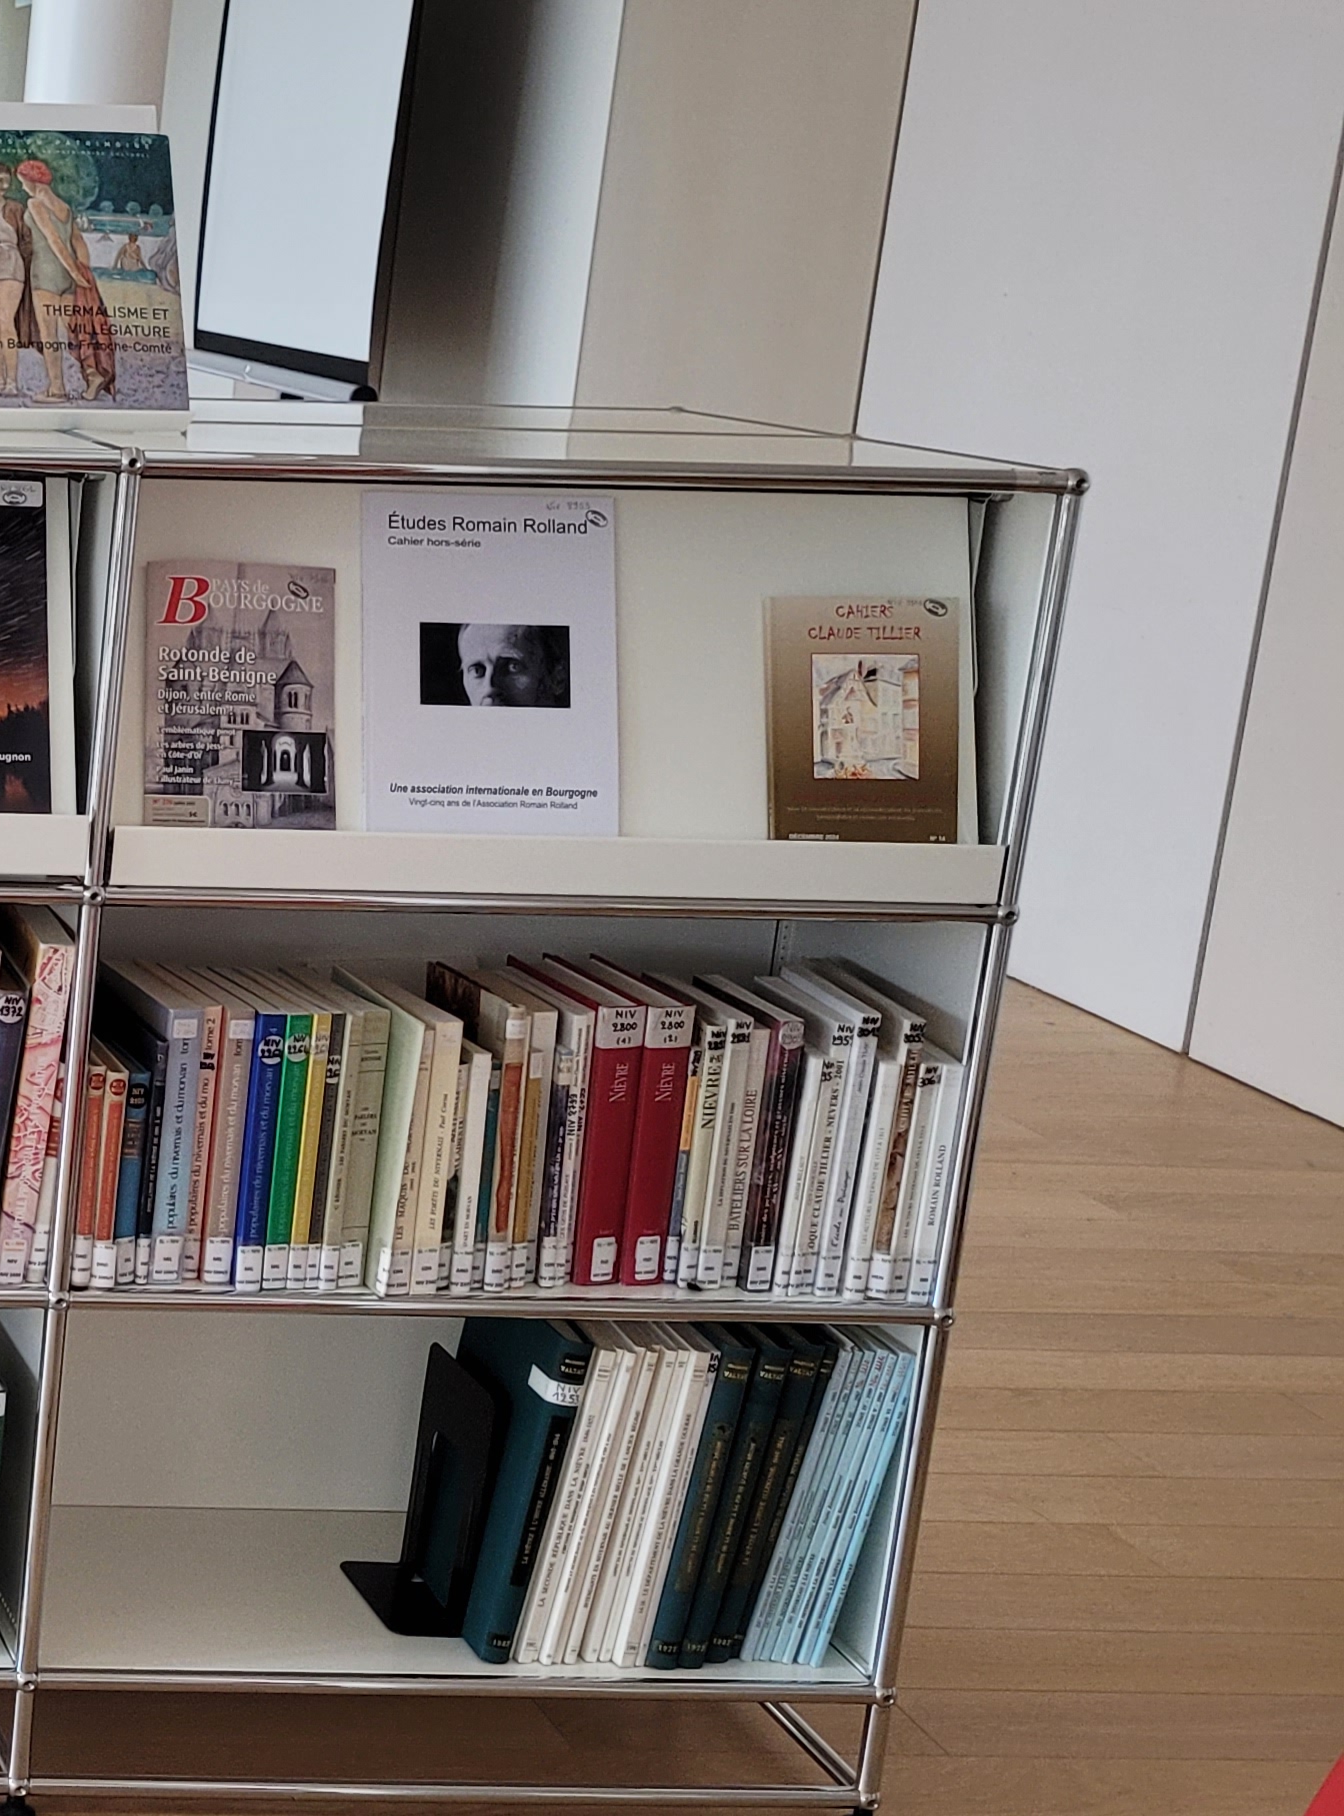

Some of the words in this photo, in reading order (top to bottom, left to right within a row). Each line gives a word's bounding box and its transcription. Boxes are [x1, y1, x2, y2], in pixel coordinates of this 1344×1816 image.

[43, 304, 148, 320] THERMALISME
[152, 307, 170, 320] ET
[388, 510, 447, 532] Études
[452, 516, 517, 533] Romain
[523, 517, 588, 535] Rolland
[387, 536, 424, 546] Cahier
[426, 536, 481, 548] hors-série
[212, 578, 250, 593] PAYS
[252, 579, 269, 594] de
[835, 604, 894, 618] CAHIERS
[808, 626, 861, 640] CLAUDE
[867, 626, 922, 641] TILLIER
[158, 646, 231, 664] Rotonde
[235, 646, 256, 664] de
[157, 664, 278, 687] Saint-Bénigne
[157, 688, 191, 703] Dijon,
[193, 689, 222, 702] entre
[224, 690, 256, 703] Rome
[157, 703, 170, 714] et
[171, 702, 227, 717] Jérusalem
[389, 782, 408, 794] Une
[410, 783, 464, 795] association
[465, 784, 530, 797] internationale
[531, 787, 544, 797] en
[545, 786, 598, 800] Bourgogne
[615, 1009, 637, 1019] NIV
[612, 1021, 637, 1032] 2800
[744, 1089, 759, 1124] LOIRE
[742, 1125, 752, 1145] LA
[738, 1144, 750, 1168] SUR
[933, 1144, 947, 1189] ROLLAND
[728, 1165, 748, 1232] BATELIERS
[927, 1186, 940, 1227] ROMAIN
